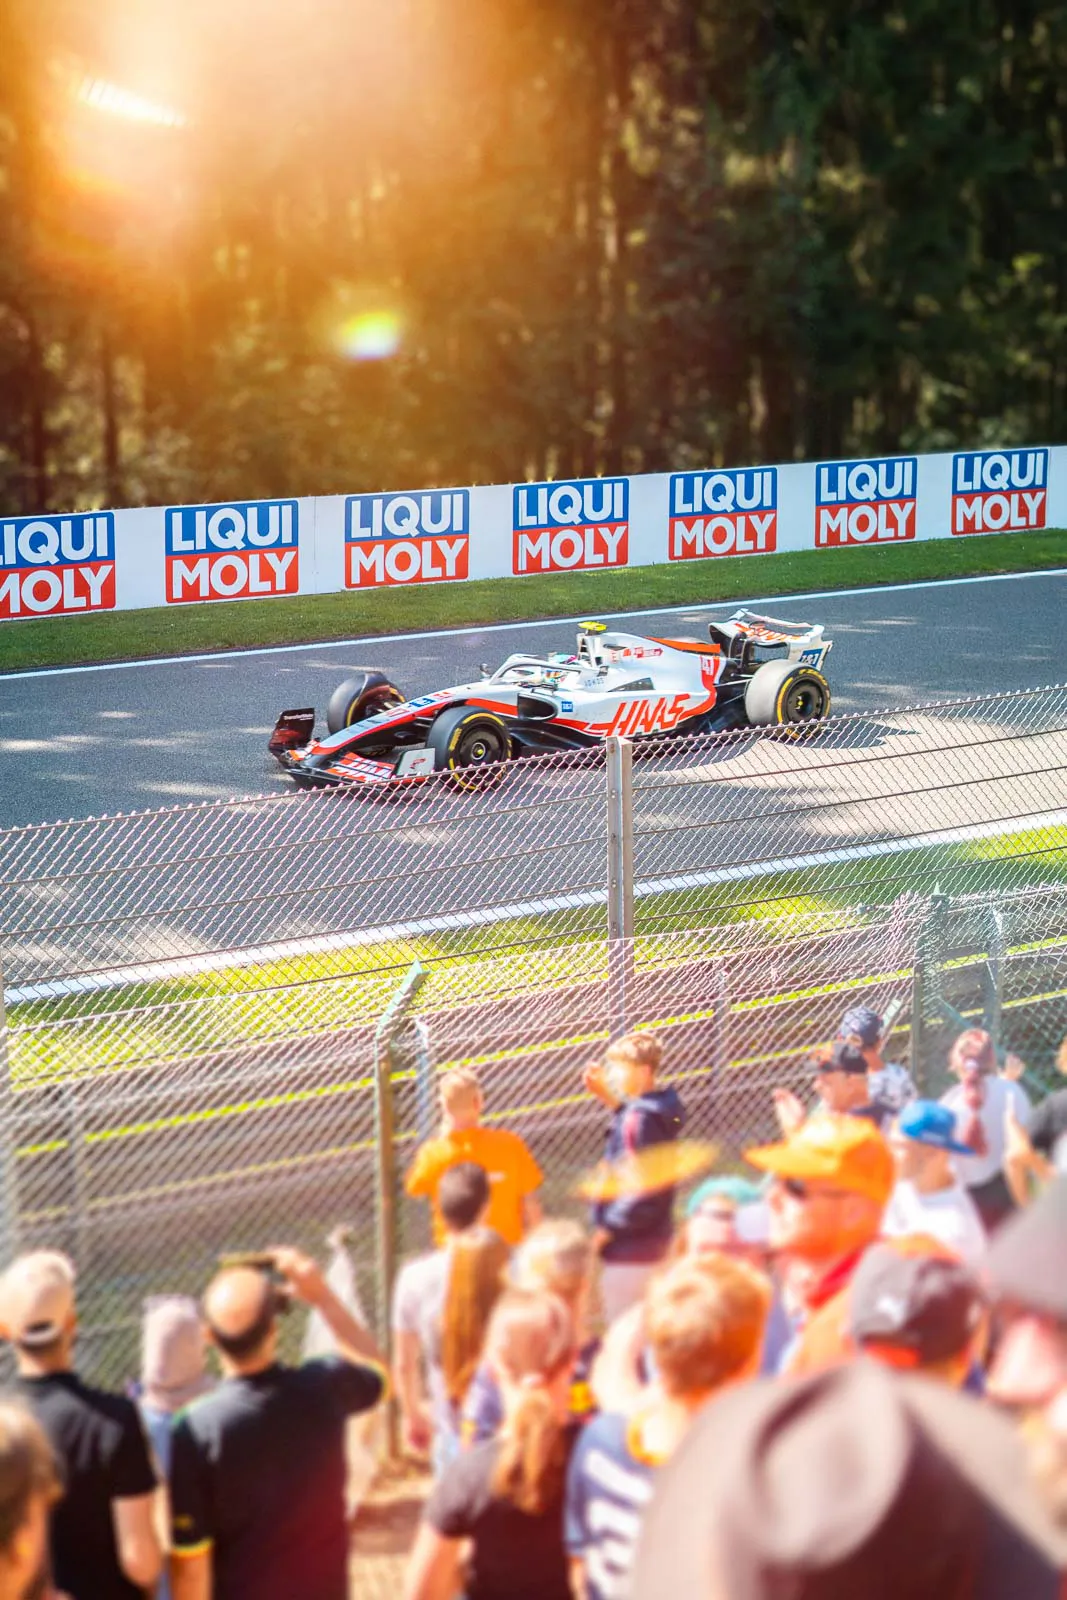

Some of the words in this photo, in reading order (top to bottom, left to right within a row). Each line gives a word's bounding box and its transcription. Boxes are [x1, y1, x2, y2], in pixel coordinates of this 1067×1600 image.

[675, 473, 771, 512] LIQUI
[821, 463, 912, 501] LIQUI
[957, 455, 1043, 491] LIQUI
[351, 493, 464, 538] LIQUI
[516, 483, 623, 529] LIQUI
[819, 502, 914, 543] MOLY
[956, 491, 1045, 531] MOLY
[0, 517, 108, 565] IQUI
[172, 506, 293, 552] LIQUI
[516, 526, 628, 571] MOLY
[673, 514, 776, 557] MOLY
[172, 552, 296, 599] MOLY
[351, 538, 467, 584] MOLY
[603, 693, 691, 737] HAAS
